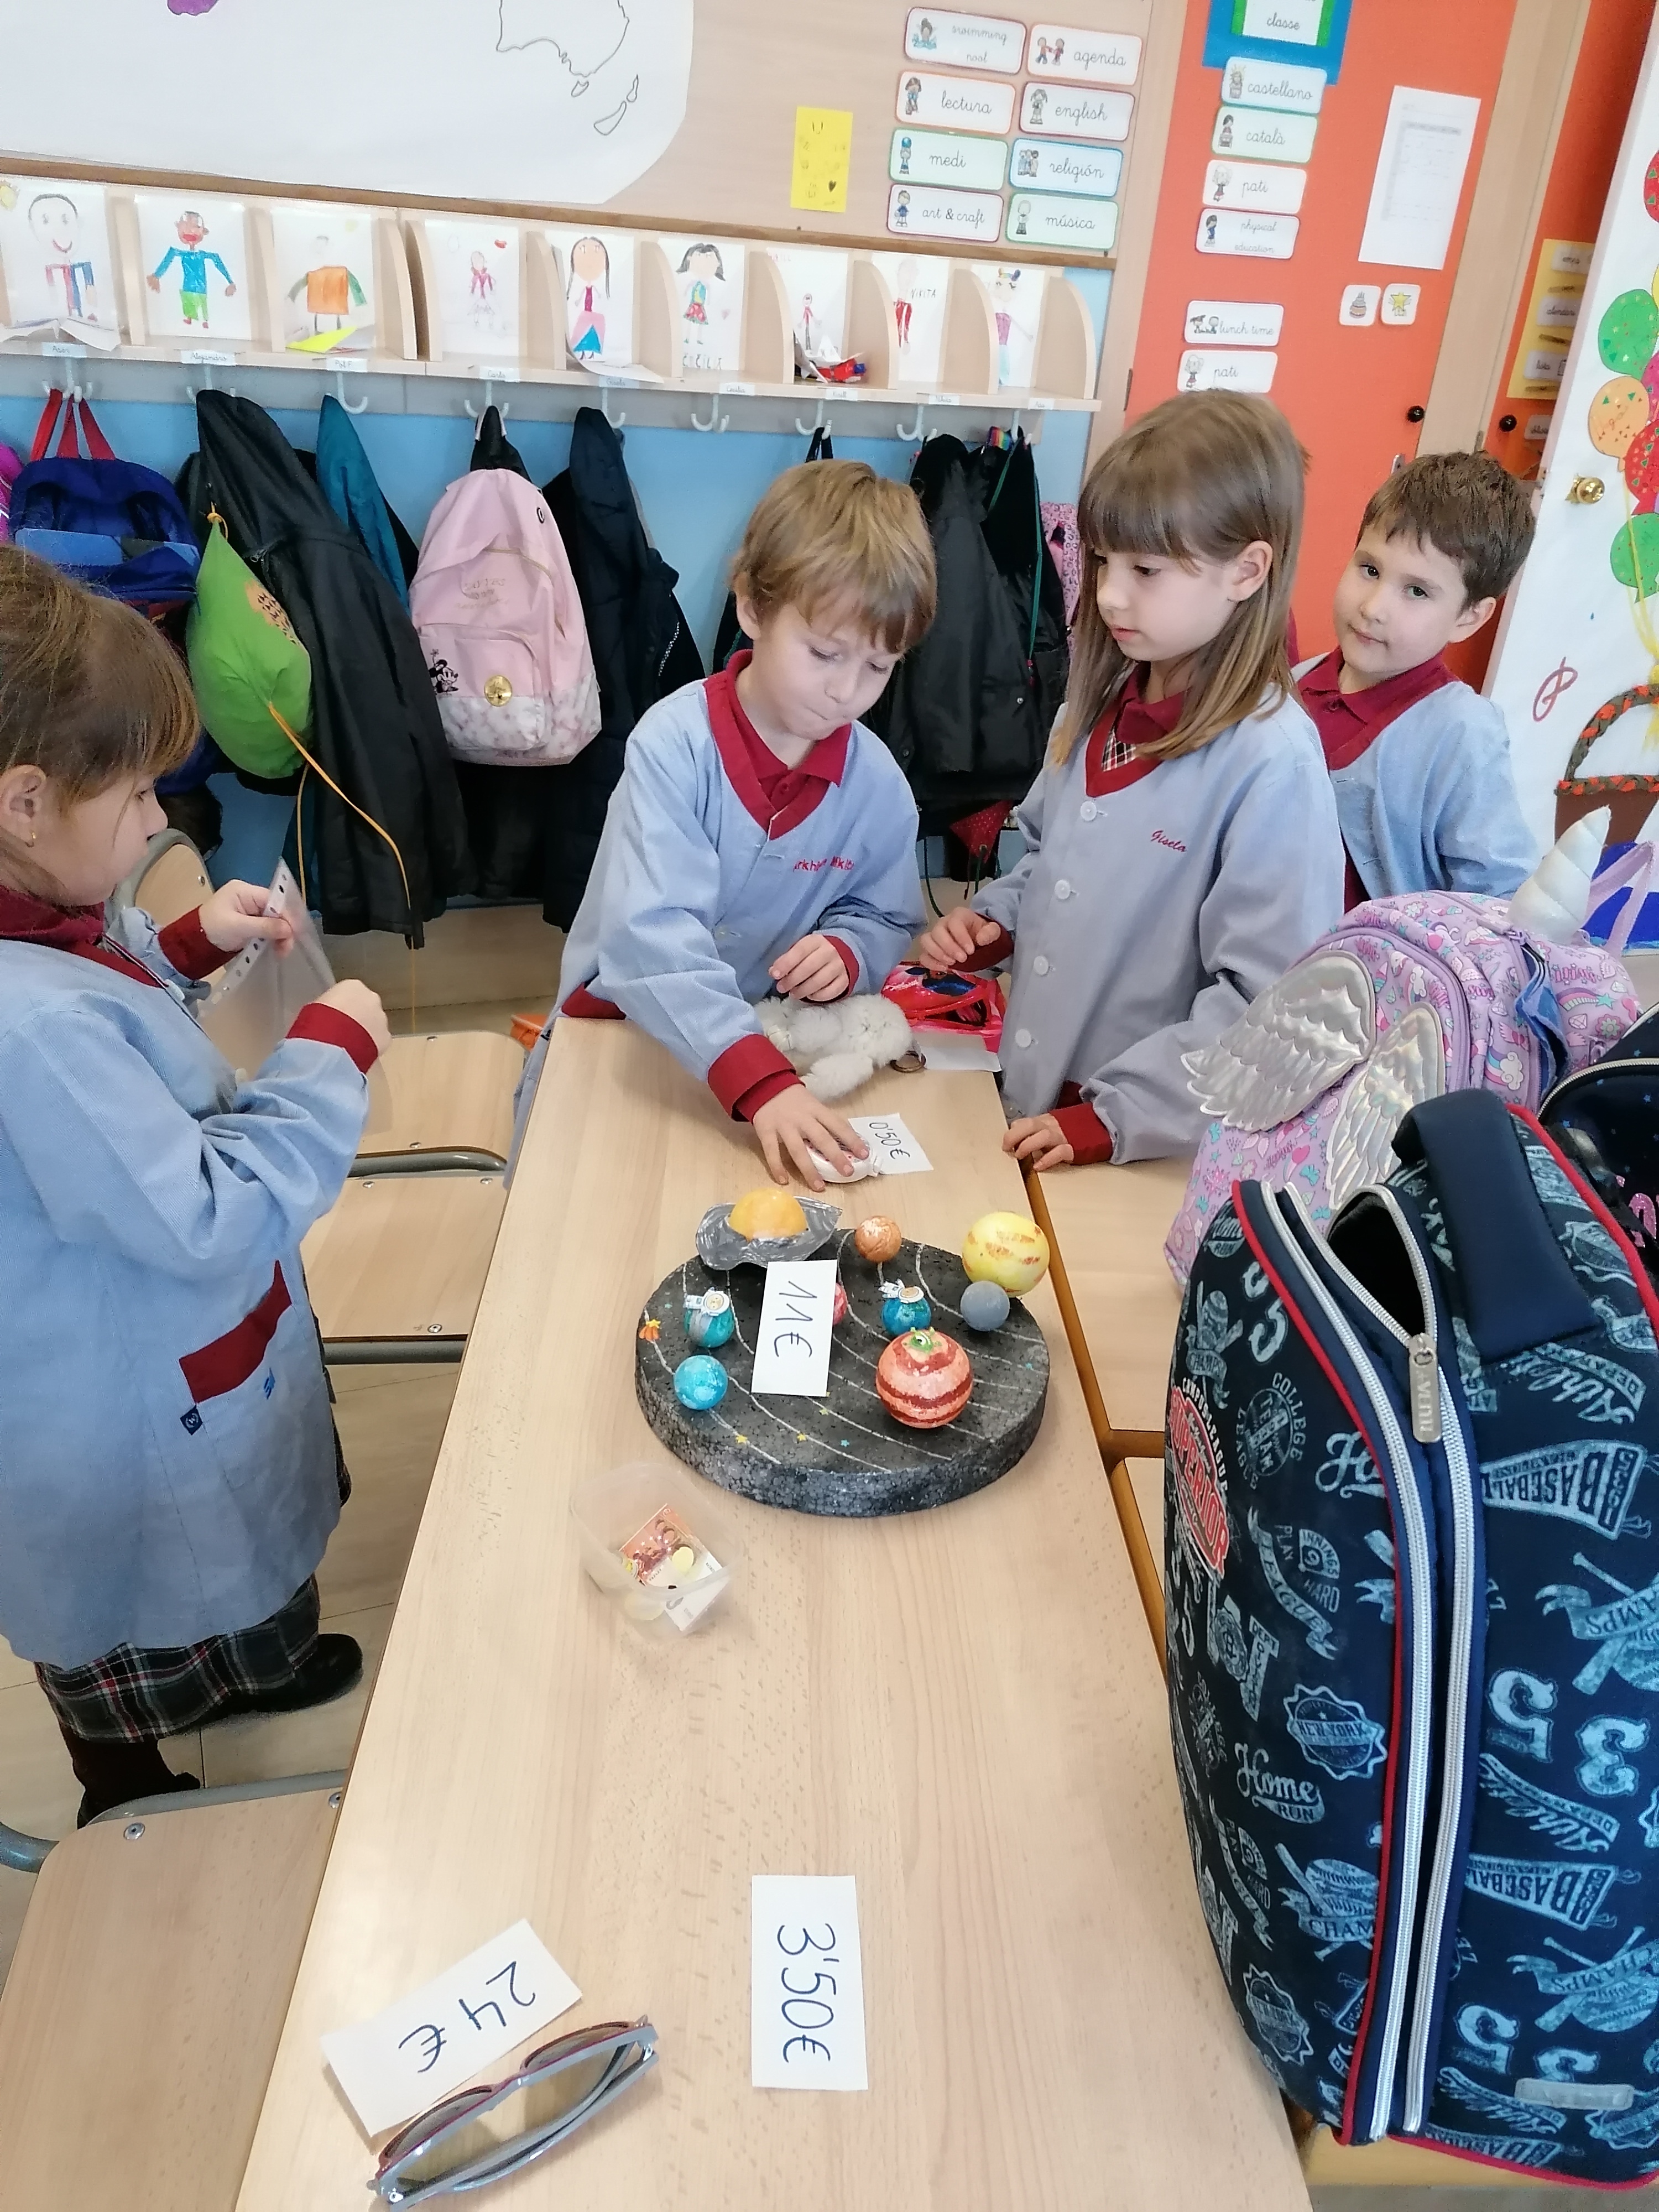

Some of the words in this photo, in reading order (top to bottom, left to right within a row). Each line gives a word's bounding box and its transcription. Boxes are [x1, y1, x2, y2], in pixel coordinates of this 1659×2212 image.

[1266, 12, 1301, 30] classe
[1073, 48, 1127, 71] agenda
[1247, 75, 1313, 101] castellano
[941, 90, 993, 115] lectura
[1055, 103, 1108, 126] english
[1245, 127, 1286, 146] català
[928, 150, 967, 169] medi
[1049, 158, 1105, 183] religión
[1241, 178, 1269, 199] pati
[922, 208, 942, 220] art
[945, 208, 954, 220] &
[956, 210, 985, 230] craft
[1045, 212, 1096, 230] música
[1240, 218, 1277, 234] physical
[911, 288, 937, 299] NIKITA
[1219, 321, 1249, 336] lunch
[1251, 323, 1275, 336] time
[1212, 363, 1239, 388] pati
[1150, 830, 1187, 853] Gisela
[869, 1121, 911, 1160] 0'50€
[1272, 1372, 1307, 1462] COLLEGE
[1170, 1386, 1229, 1580] SUPERIOR
[1274, 1525, 1294, 1561] PLAY
[1302, 1531, 1338, 1575] INNINGS
[1304, 1549, 1321, 1566] 9
[1303, 1578, 1340, 1613] HARD
[1490, 1669, 1556, 1762] 5
[1298, 1721, 1327, 1738] NEW
[1327, 1721, 1365, 1740] YORK
[1234, 1742, 1321, 1804] Home
[1277, 1802, 1314, 1822] RUN
[1551, 1946, 1653, 1994] CHAMPS
[775, 1922, 840, 2064] 3'50€
